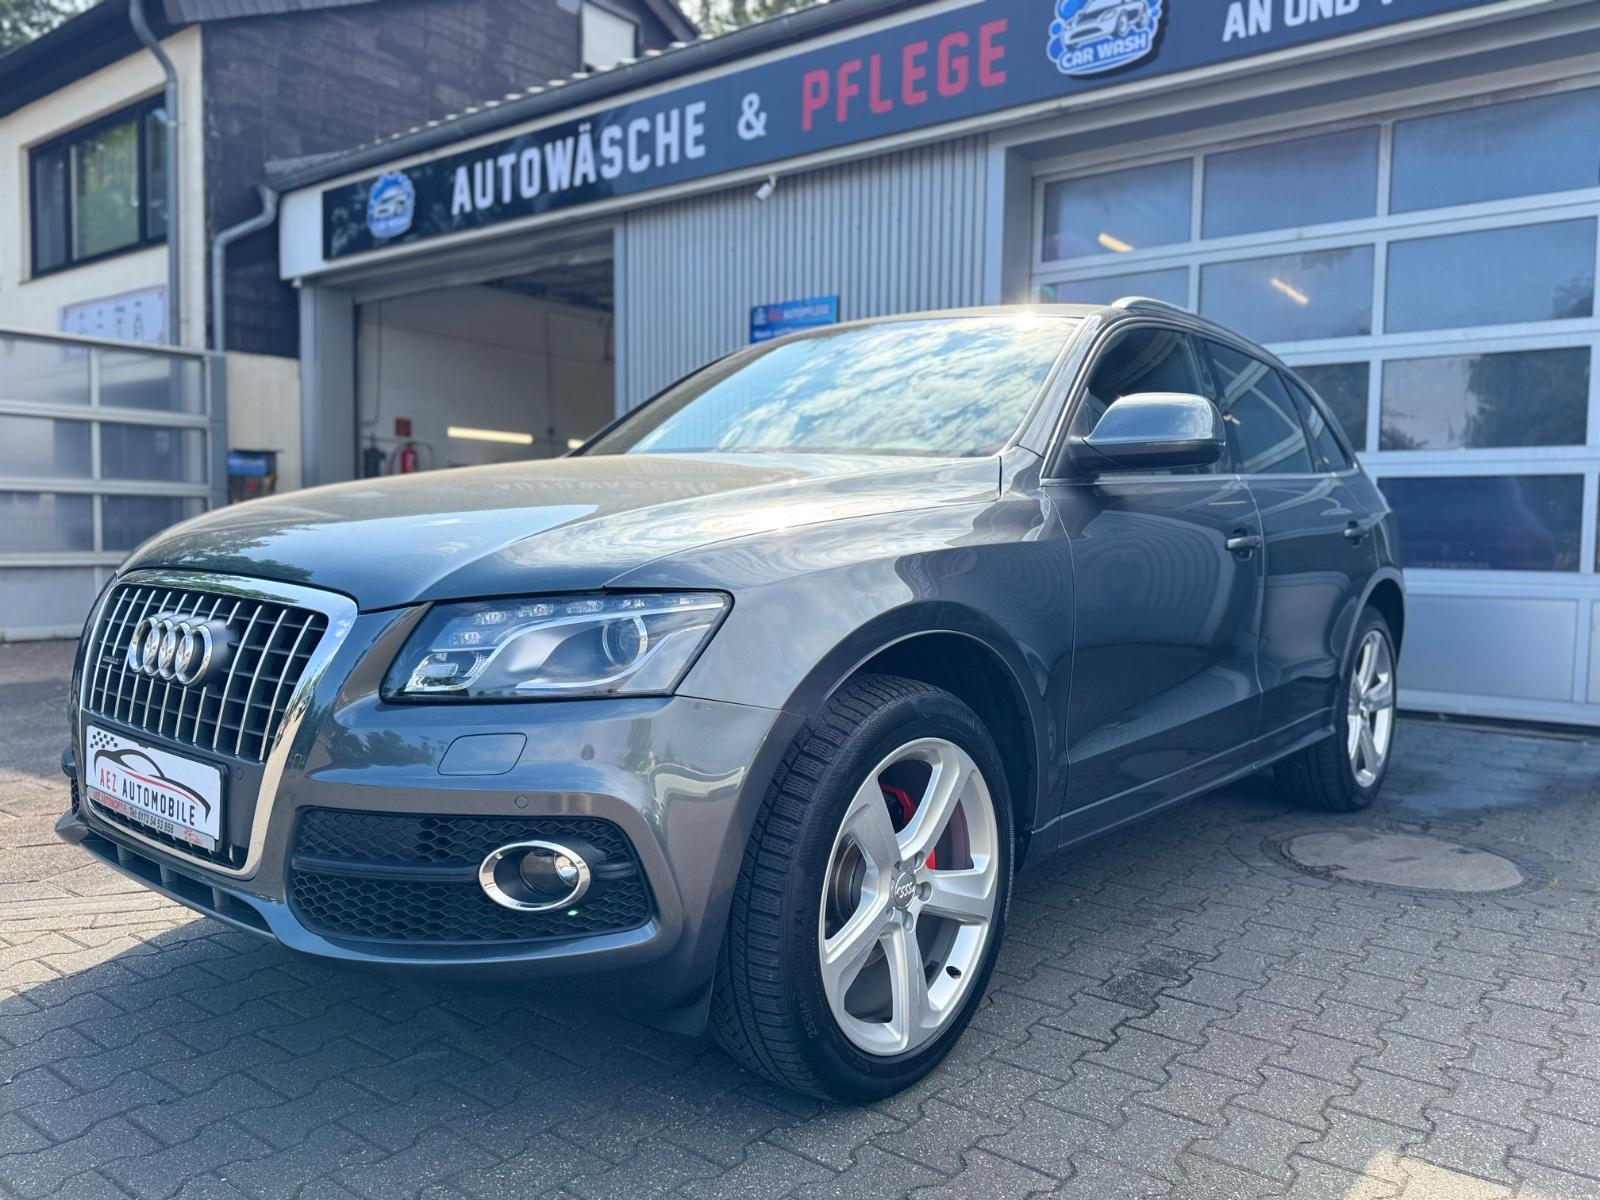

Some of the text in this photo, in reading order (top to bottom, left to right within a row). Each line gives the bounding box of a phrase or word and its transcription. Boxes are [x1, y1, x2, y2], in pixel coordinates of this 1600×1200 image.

[1222, 0, 1272, 42] AN
[1062, 32, 1147, 68] CAR WASH
[451, 18, 1008, 216] AUTOWÄSCHE & PFLEGE
[100, 767, 195, 826] AEZ AUTOMOBILE
